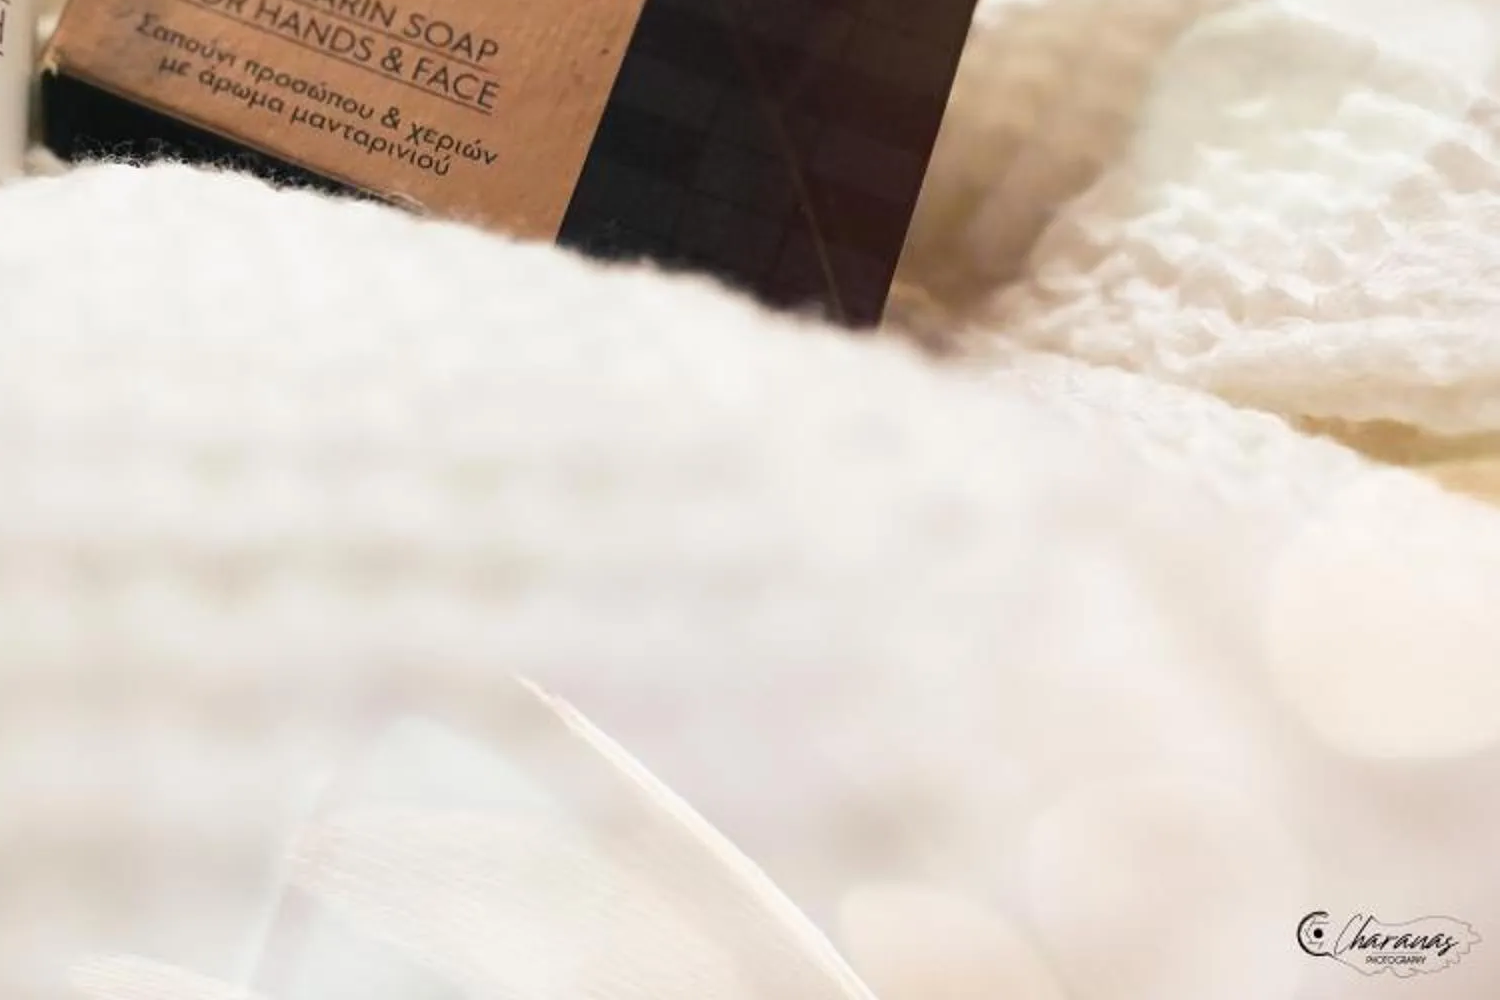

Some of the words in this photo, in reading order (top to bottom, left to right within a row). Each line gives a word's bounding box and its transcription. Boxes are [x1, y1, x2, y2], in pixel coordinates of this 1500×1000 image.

[403, 12, 500, 64] SOAP
[136, 11, 237, 66] Σαπούνι
[243, 56, 375, 122] προσώπου
[380, 104, 402, 131] &
[406, 121, 500, 167] χεριών
[380, 46, 404, 74] &
[412, 57, 501, 110] FACE
